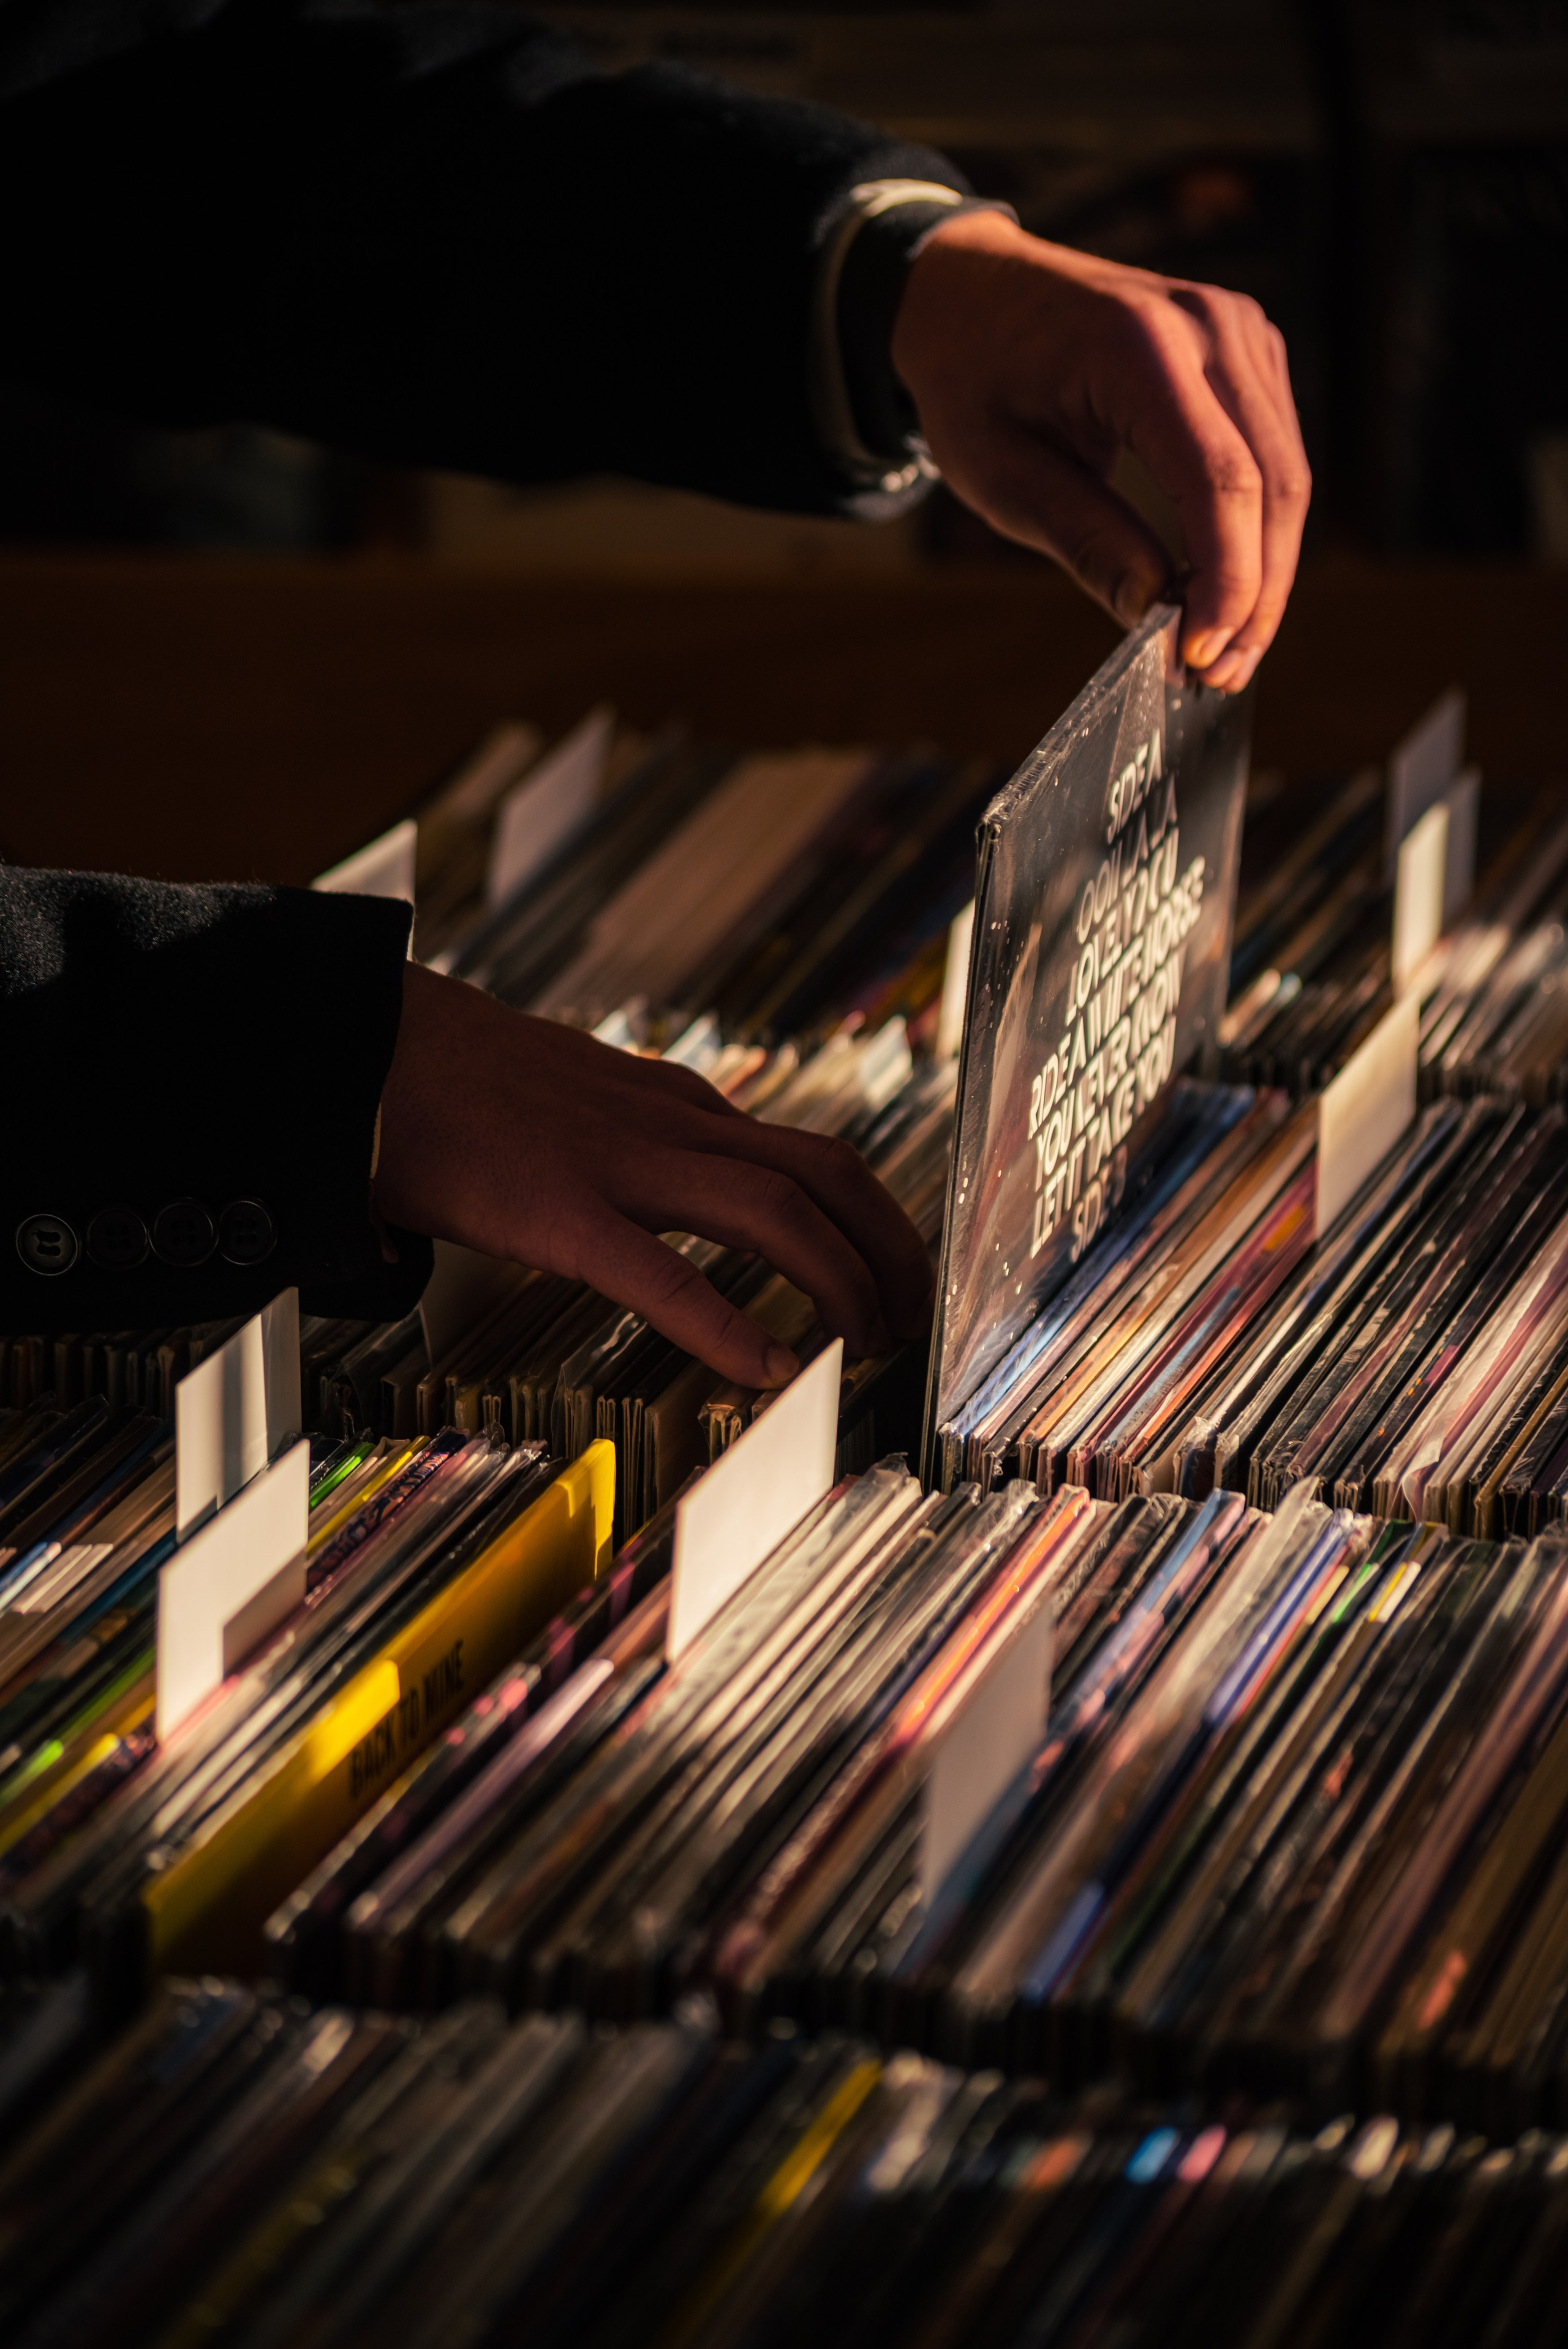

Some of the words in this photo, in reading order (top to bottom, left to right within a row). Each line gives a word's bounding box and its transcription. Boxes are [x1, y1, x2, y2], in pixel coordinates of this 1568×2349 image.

[1107, 742, 1148, 844] SIDE
[1144, 726, 1162, 796] A
[1076, 839, 1122, 945] OOH
[1027, 1032, 1071, 1141] RIDE
[1067, 1015, 1087, 1087] A
[1087, 935, 1144, 1056] WHITE
[1140, 854, 1205, 984] HORSE
[1035, 1088, 1076, 1193] YOU
[1073, 1014, 1131, 1139] NEVER
[1129, 942, 1186, 1061] KNOW
[1030, 1161, 1067, 1259] LET
[1065, 1135, 1087, 1212] IT
[1086, 1068, 1136, 1183] TAKE
[1136, 1014, 1177, 1116] YOU
[1070, 1163, 1112, 1263] SIDE
[349, 1714, 396, 1801] BACK
[399, 1687, 420, 1749] TO
[423, 1638, 465, 1722] MINE
